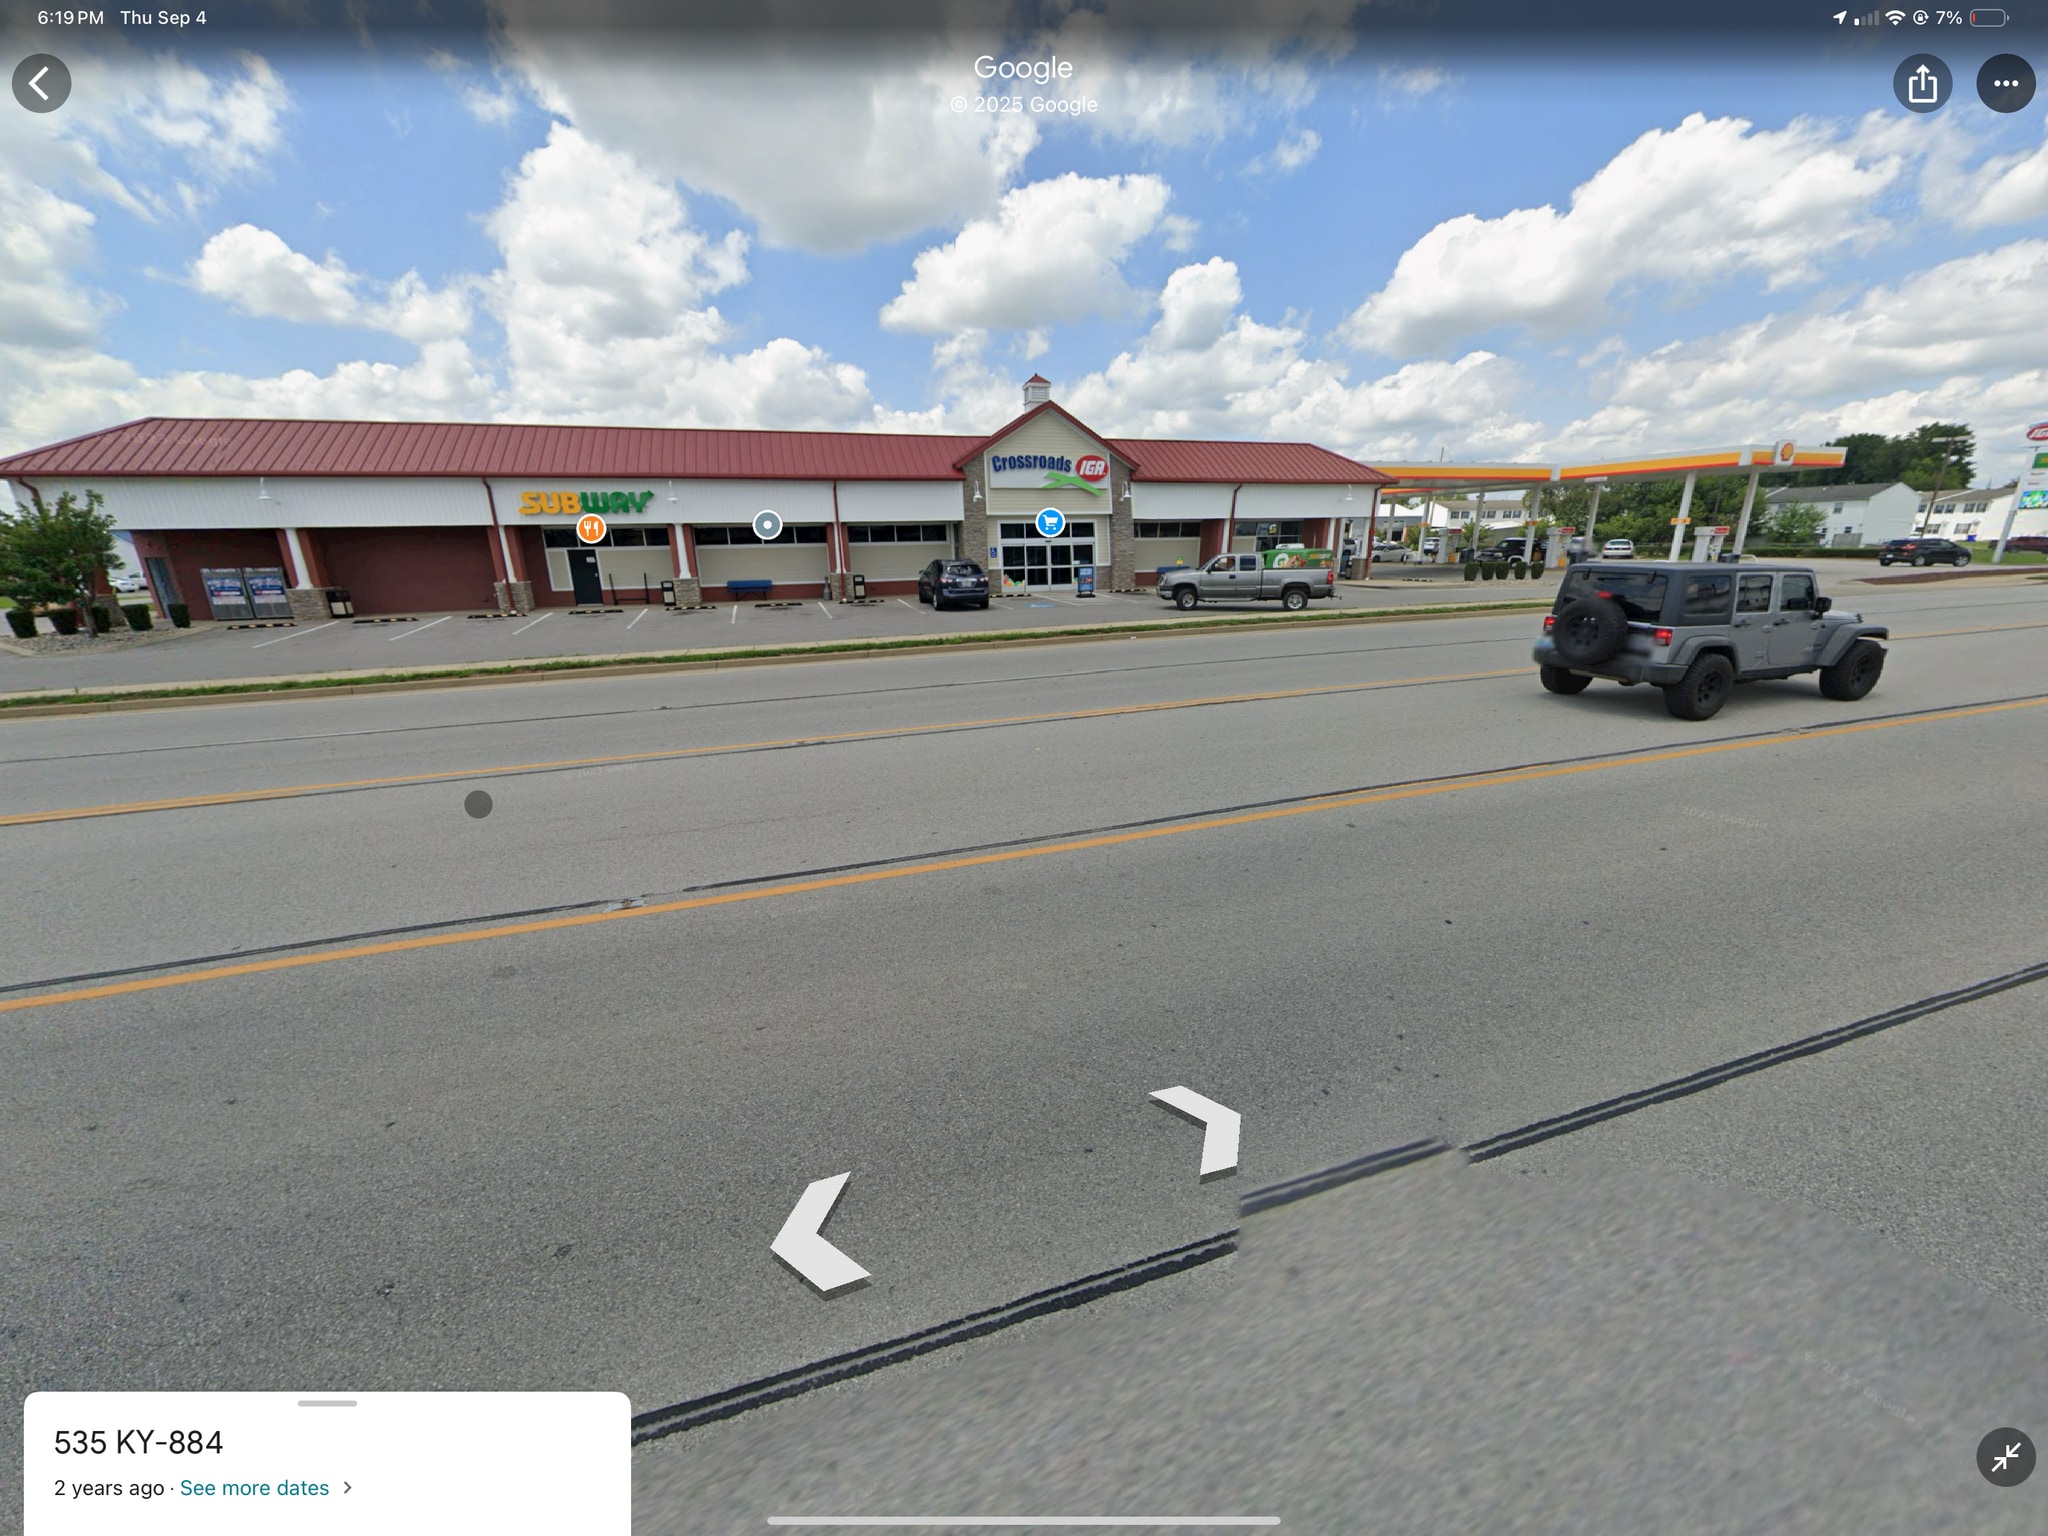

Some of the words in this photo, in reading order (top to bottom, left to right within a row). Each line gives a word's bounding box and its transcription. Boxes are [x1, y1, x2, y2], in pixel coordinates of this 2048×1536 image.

[991, 454, 1072, 473] Crossroads
[1080, 460, 1106, 476] IGA
[518, 490, 655, 515] SUBWAY
